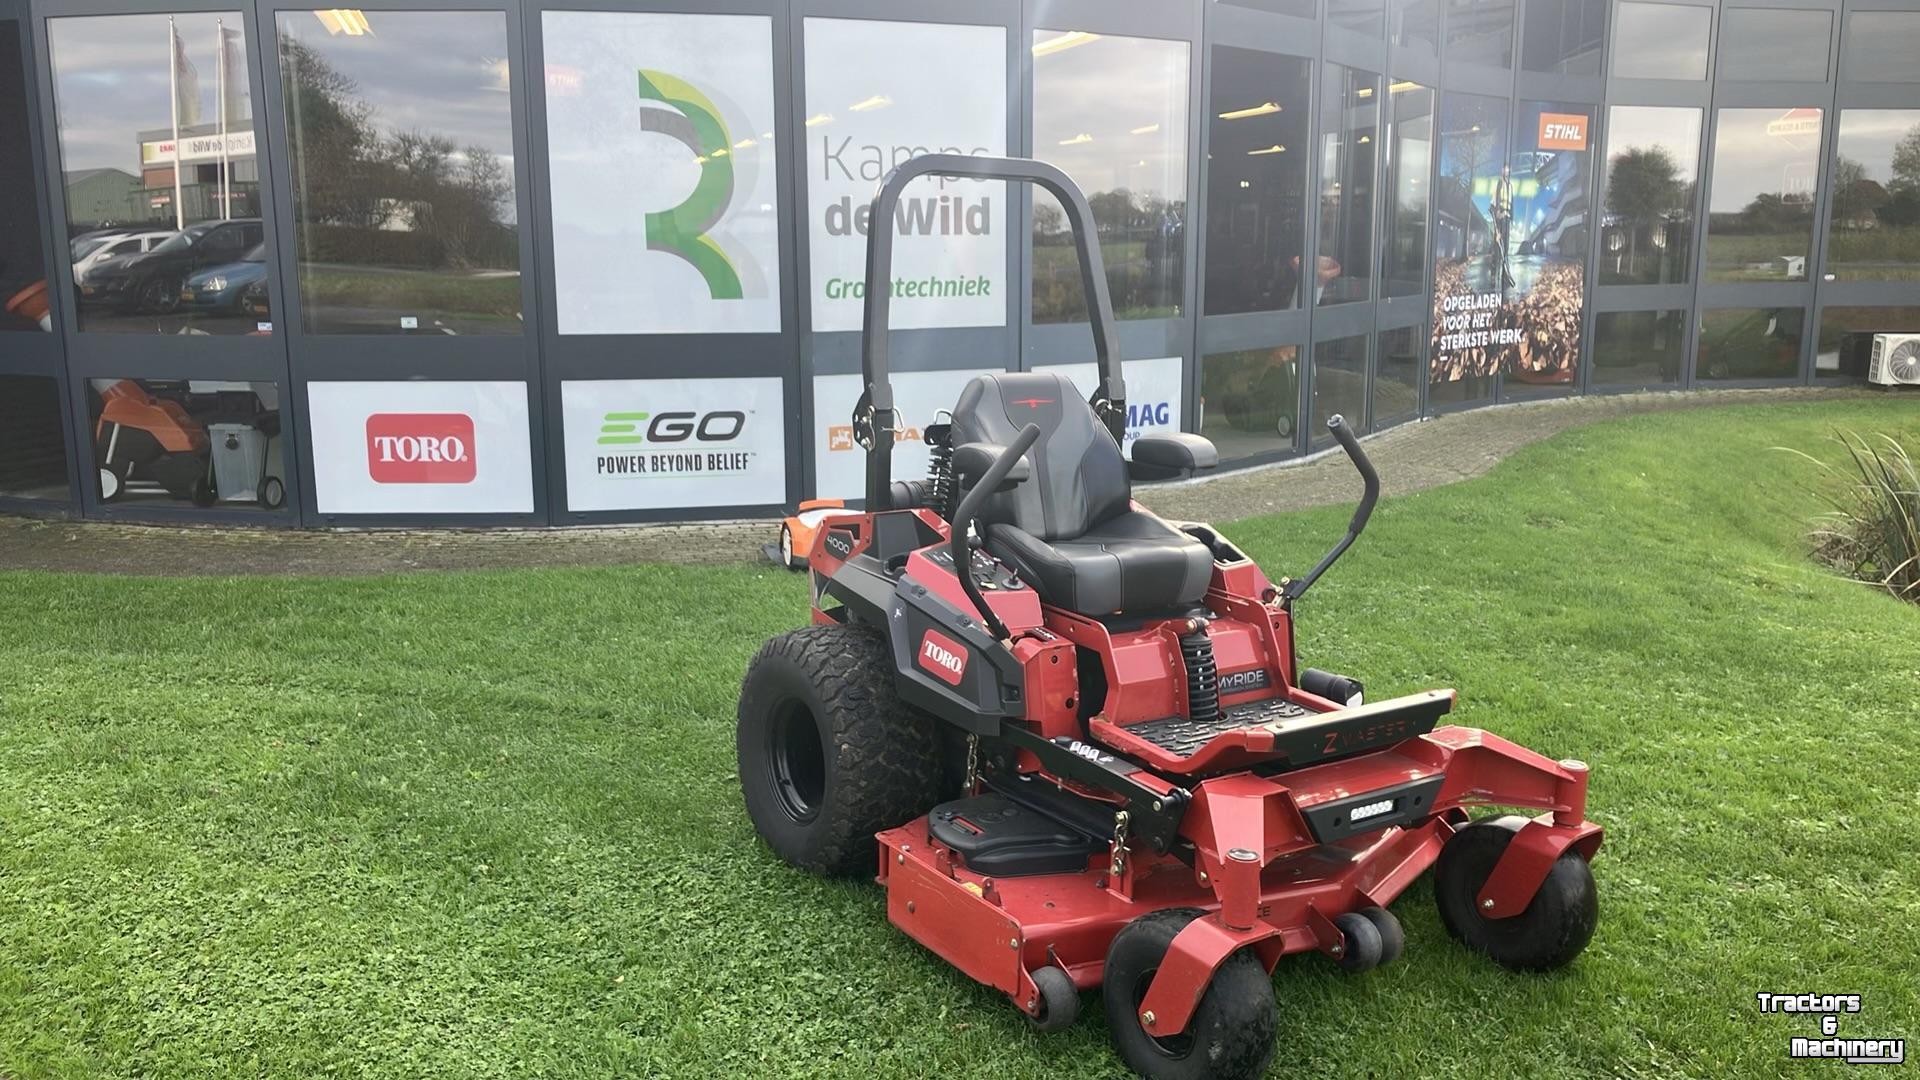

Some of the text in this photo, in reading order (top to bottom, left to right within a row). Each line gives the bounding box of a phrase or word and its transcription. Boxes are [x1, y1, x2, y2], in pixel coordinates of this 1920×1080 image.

[1543, 123, 1583, 140] STIHL
[824, 195, 991, 237] de Wild
[825, 275, 991, 299] Grotechniek
[1443, 293, 1502, 312] OPGELADEN
[1442, 314, 1471, 331] VOOR
[1440, 331, 1489, 350] STERKSTE
[597, 452, 749, 474] POWER BEYOND BELIEF
[827, 536, 850, 554] 4000
[1322, 731, 1339, 754] Z
